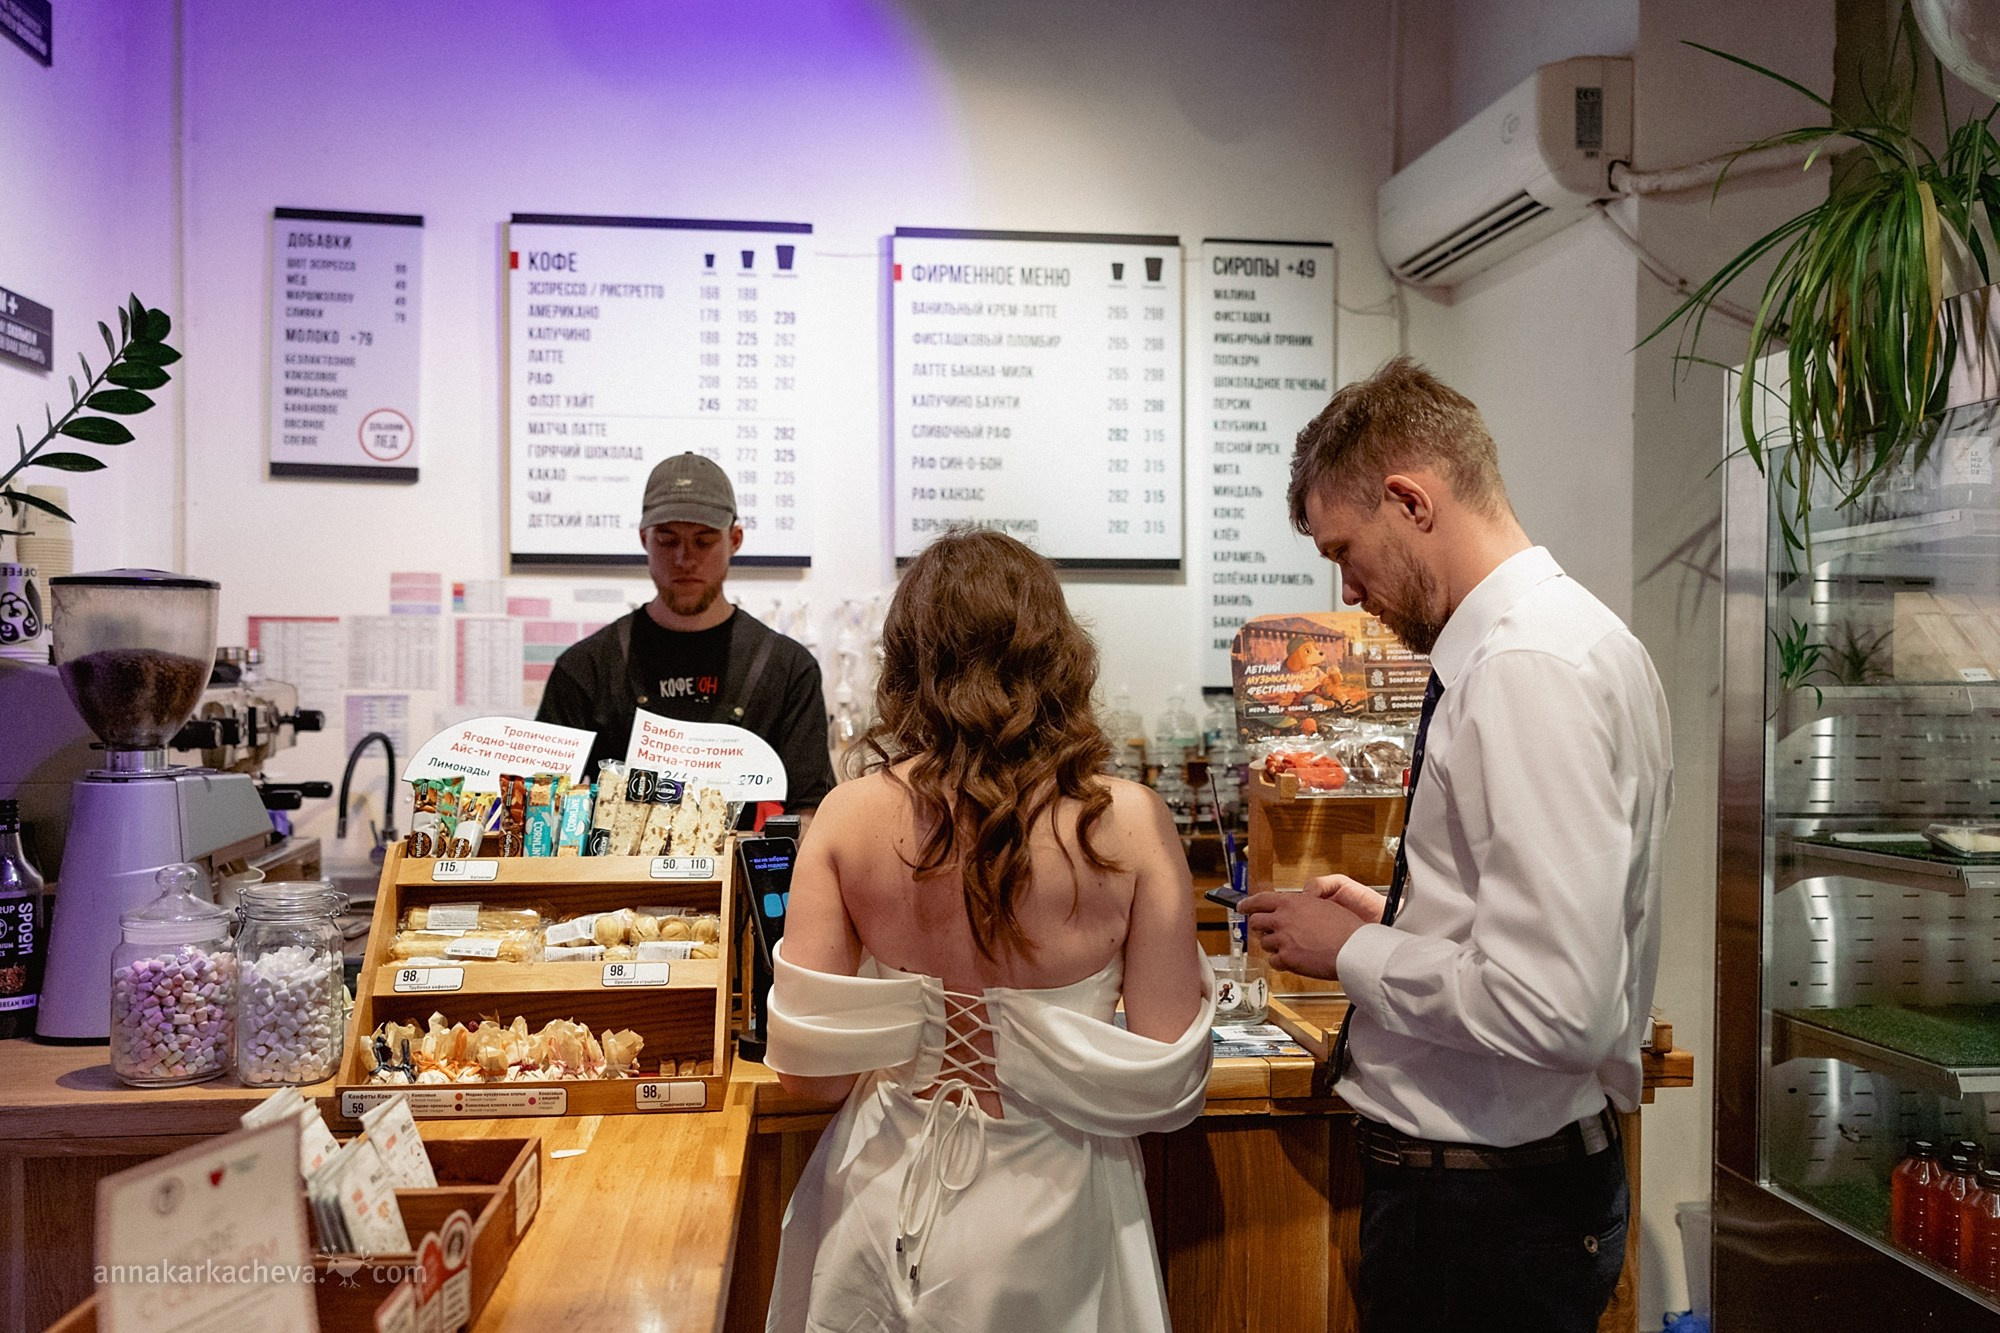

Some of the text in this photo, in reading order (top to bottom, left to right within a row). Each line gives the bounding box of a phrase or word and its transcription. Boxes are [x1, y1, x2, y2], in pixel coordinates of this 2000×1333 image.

[288, 233, 352, 249] ДОБАВКИ
[528, 251, 578, 272] КОФЕ
[1213, 256, 1316, 278] СИРОПЫ +49
[912, 264, 1071, 287] ФИРМЕННОЕ МЕНЮ
[528, 281, 587, 297] ЭСПРЕССО
[600, 283, 665, 299] РИСТРЕТТО
[1213, 289, 1256, 301] МАЛИНА
[528, 304, 600, 320] АМЕРИКАНО
[912, 299, 984, 316] ВАНИЛЬНЫЙ
[1213, 311, 1271, 324] ФИСТАШКА
[286, 328, 340, 344] МОЛОКО
[528, 326, 591, 343] КАПУЧИНО
[736, 331, 758, 346] 225
[912, 332, 1003, 348] ФИСТАШКОВЫЙ
[1006, 333, 1062, 349] ПЛОМБИР
[1273, 334, 1314, 347] ПРЯНИК
[528, 349, 564, 364] ЛАТТЕ
[736, 353, 758, 367] 225
[528, 371, 554, 386] РАФ
[912, 363, 946, 378] ЛАТТЕ
[528, 392, 720, 412] ФЛЭТ УАЙТ 245
[912, 394, 973, 410] КАПУЧИНО
[976, 395, 1021, 411] БАУНТИ
[528, 422, 568, 437] МАТЧА
[571, 422, 606, 437] ЛАТТЕ
[912, 424, 984, 440] СЛИВОЧНЫЙ
[987, 427, 1012, 440] РАФ
[1144, 428, 1165, 443] 315
[528, 442, 581, 459] ГОРЯЧИЙ
[584, 446, 643, 461] ШОКОЛАД
[774, 448, 796, 463] 325
[912, 456, 937, 470] РАФ
[1144, 459, 1165, 474] 315
[1213, 464, 1241, 475] МЯТА
[528, 468, 567, 482] КАКАО
[528, 490, 552, 506] ЧАЙ
[912, 487, 937, 501] РАФ
[939, 488, 985, 502] КАНЗАС
[1144, 489, 1165, 505] 315
[1213, 485, 1263, 498] МИНДАЛЬ
[528, 512, 621, 529] ДЕТСКИЙ ЛАТТЕ
[1213, 507, 1245, 519] КОКОС
[1144, 520, 1165, 535] 315
[1213, 551, 1266, 563] КАРАМЕЛЬ
[1261, 573, 1315, 585] КАРАМЕЛЬ
[1213, 594, 1253, 607] ВАНИЛЬ
[1244, 661, 1281, 676] ЛЕТНИЙ
[1246, 671, 1317, 686] МУЗЫКАЛЬНЫЙ
[659, 677, 695, 697] КОФЕ
[1247, 682, 1304, 696] ФЕСТИВАЛЬ
[503, 725, 580, 748] Тропический
[642, 720, 684, 740] Бамбл
[462, 731, 576, 759] Ягодно-цветочный
[640, 734, 744, 757] Эспрессо-тоник
[450, 742, 572, 773] Айс-ти персик-юдзу
[637, 747, 722, 770] Матча-тоник
[427, 757, 490, 777] Лимонады
[739, 774, 764, 786] 270
[662, 858, 706, 869] 50 110
[402, 969, 417, 982] 98
[610, 964, 624, 976] 98
[642, 1084, 658, 1099] 98
